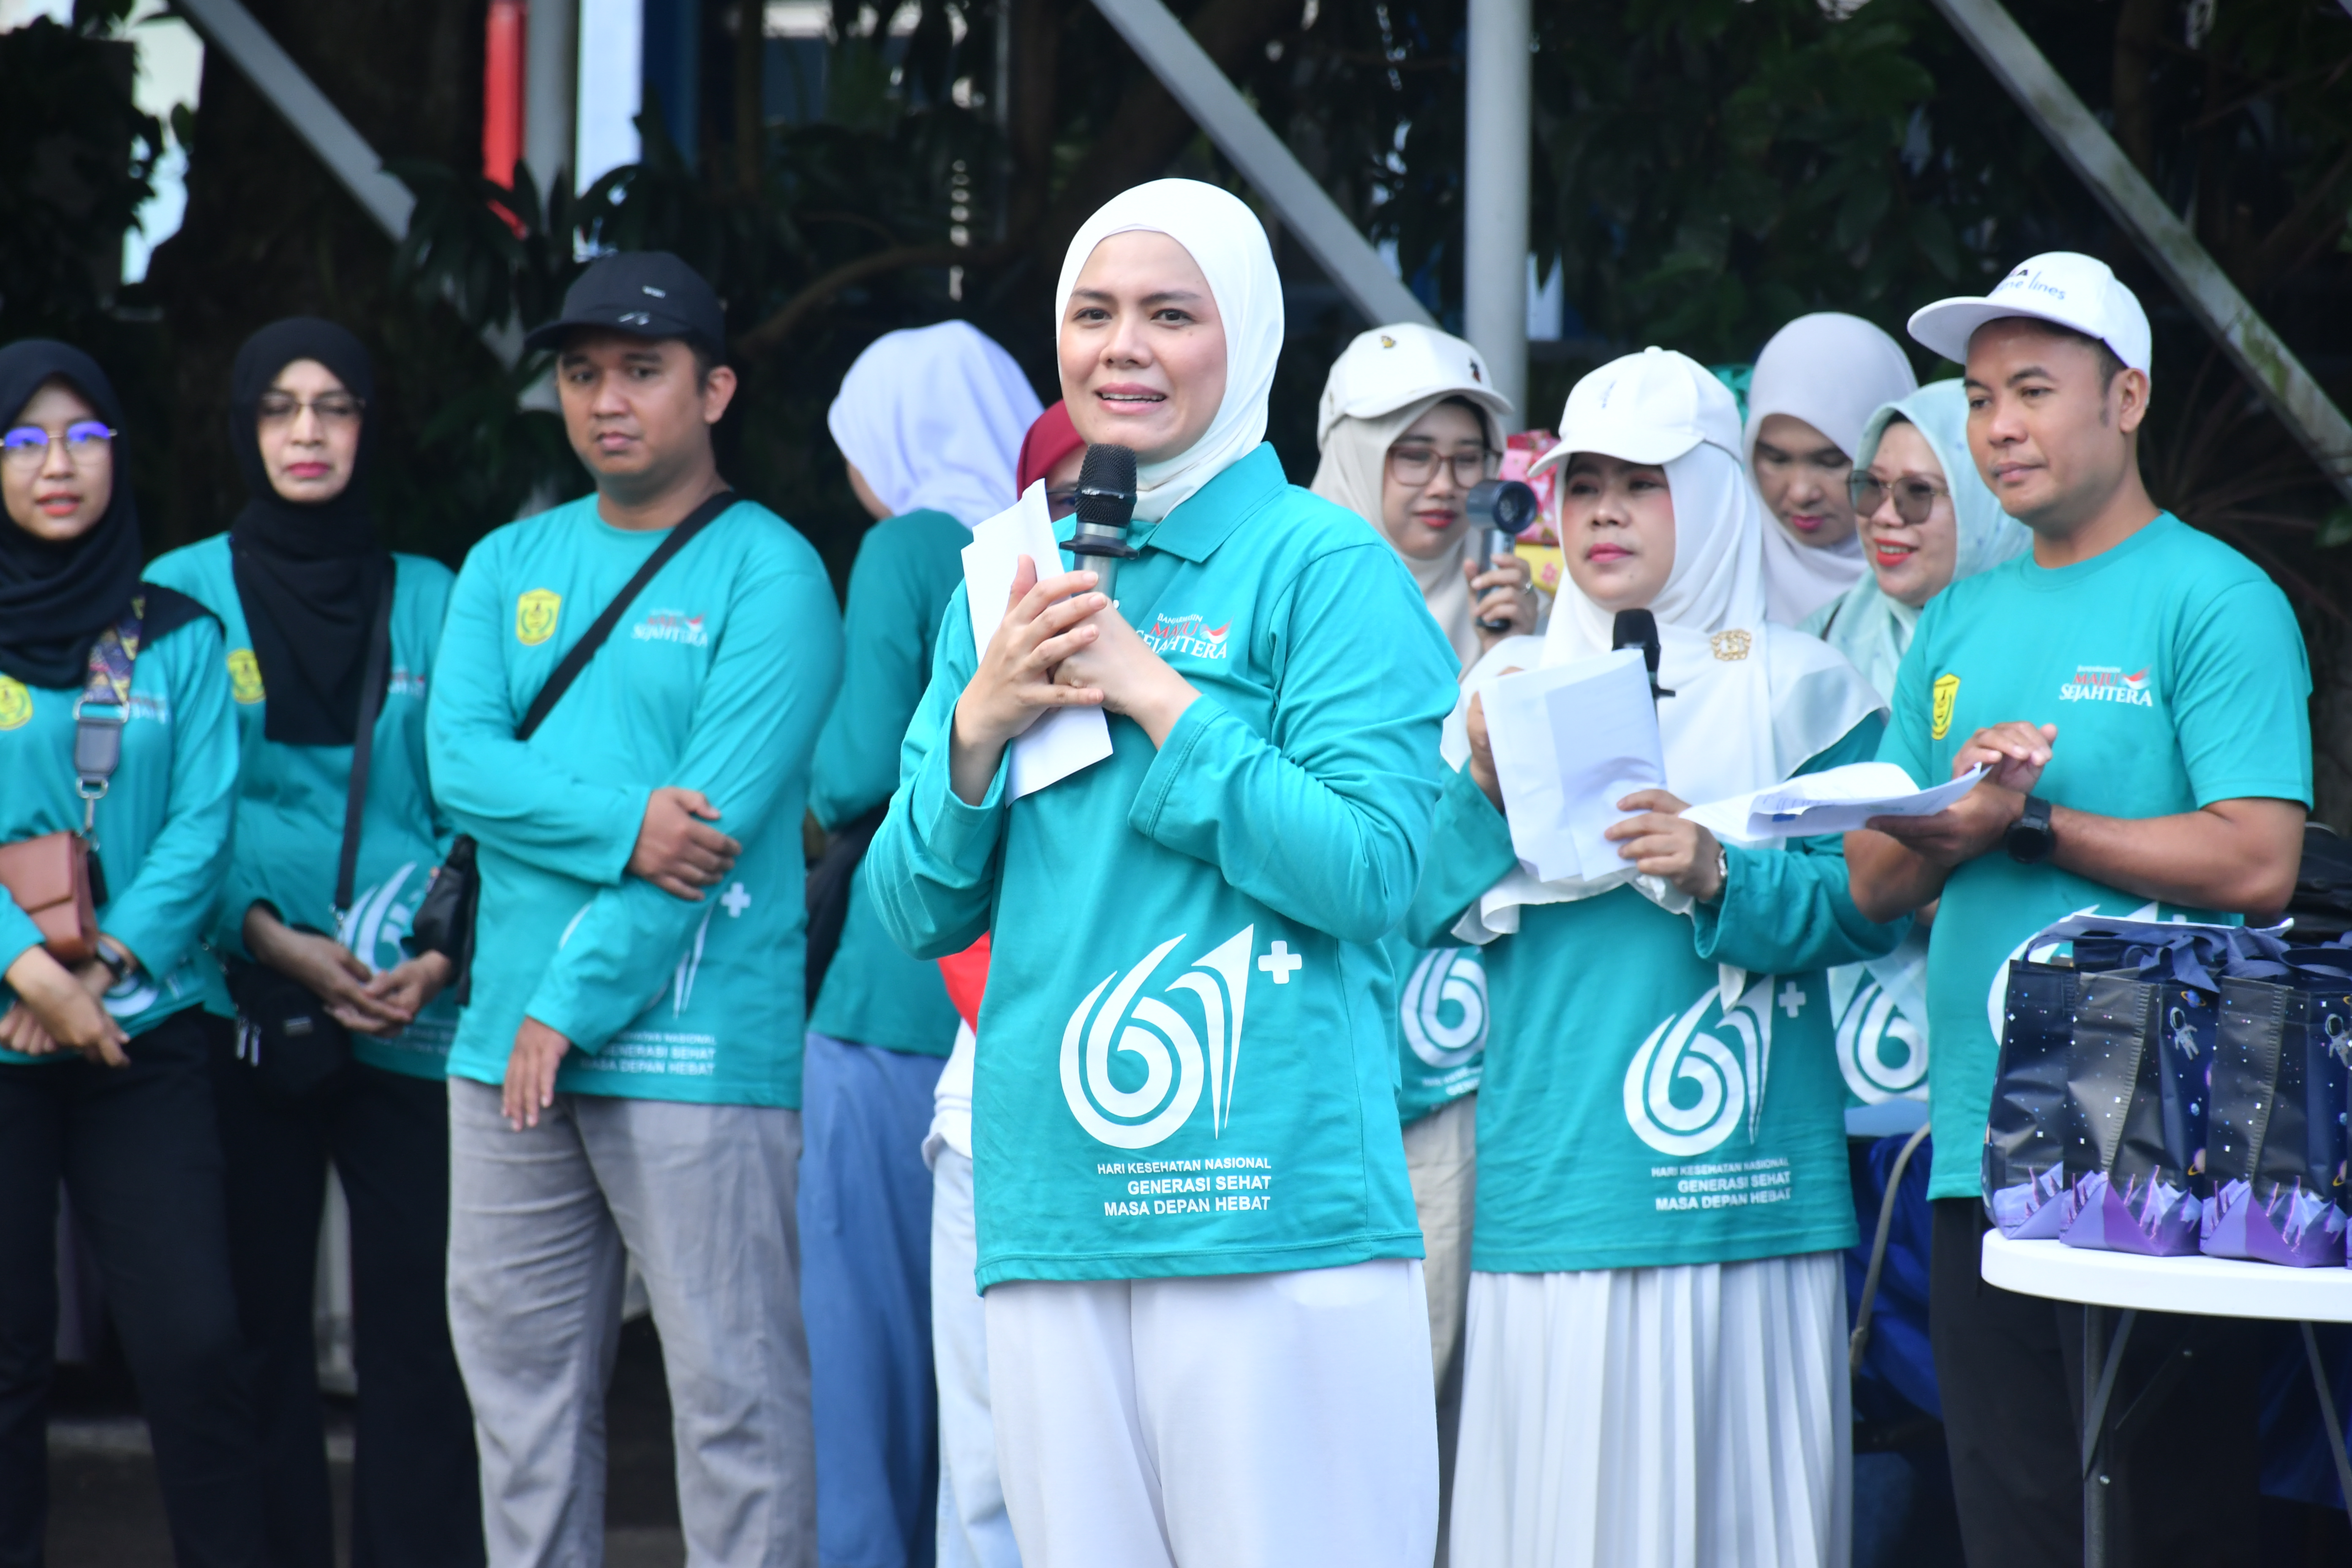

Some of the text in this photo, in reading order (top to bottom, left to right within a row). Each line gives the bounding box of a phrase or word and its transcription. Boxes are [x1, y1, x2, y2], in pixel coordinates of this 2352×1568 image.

[2028, 271, 2066, 299] lines
[1157, 612, 1203, 624] BANJARMASIN
[2072, 673, 2120, 689] MAJU
[2059, 683, 2153, 707] SEJAHTERA
[671, 1045, 716, 1060] SEHAT
[619, 1059, 665, 1073] DEPAN
[667, 1061, 716, 1076] HEBAT
[1097, 1157, 1272, 1174] HARI KESEHATAN NASIONAL
[1651, 1158, 1789, 1177] HARI KESEHATAN NASIONAL
[1127, 1176, 1272, 1195] GENERASI SEHAT
[1677, 1171, 1791, 1193] GENERASI SEHAT
[1104, 1196, 1271, 1216] MASA DEPAN HEBAT
[1655, 1187, 1791, 1211] MASA DEPAN HEBAT
